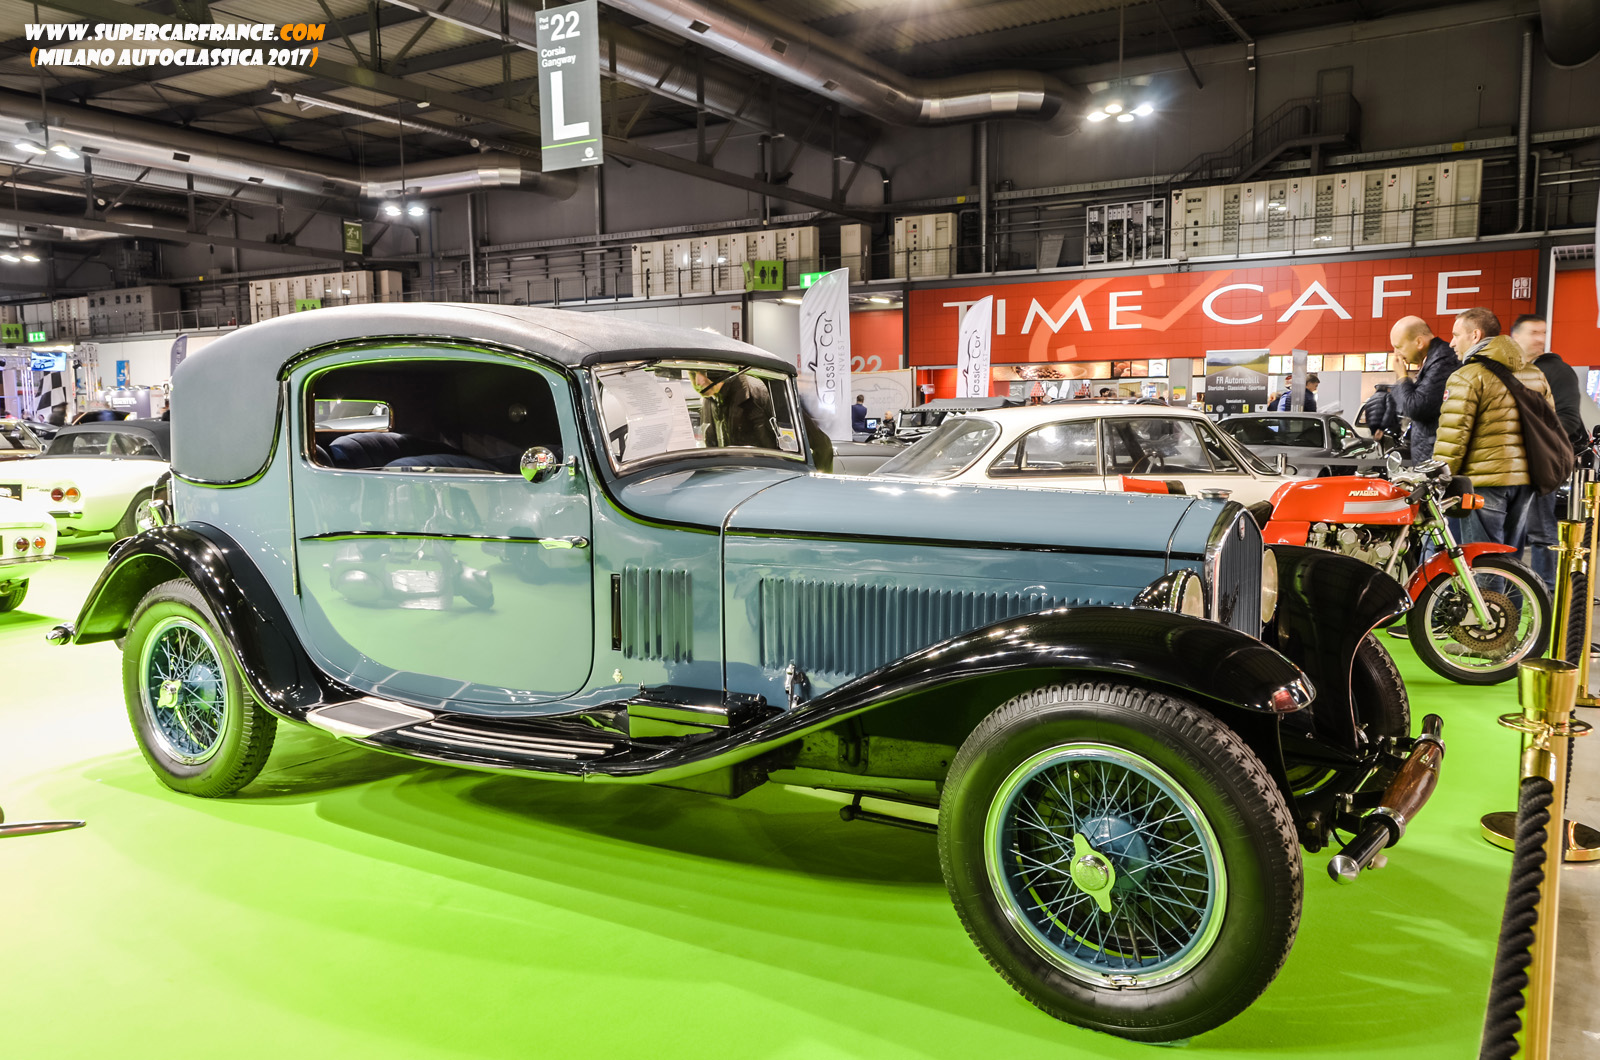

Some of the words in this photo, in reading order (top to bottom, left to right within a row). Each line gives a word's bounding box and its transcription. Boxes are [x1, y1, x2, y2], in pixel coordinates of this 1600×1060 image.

[550, 11, 581, 41] 22
[541, 46, 566, 58] Corsia
[541, 54, 577, 68] Gangway
[550, 70, 590, 141] L
[943, 290, 1143, 336] TIME
[1201, 269, 1483, 326] CAFE
[819, 318, 834, 347] Car
[971, 335, 982, 359] Car
[837, 339, 845, 375] INVEST
[822, 353, 836, 405] Classic
[969, 363, 981, 398] lassic
